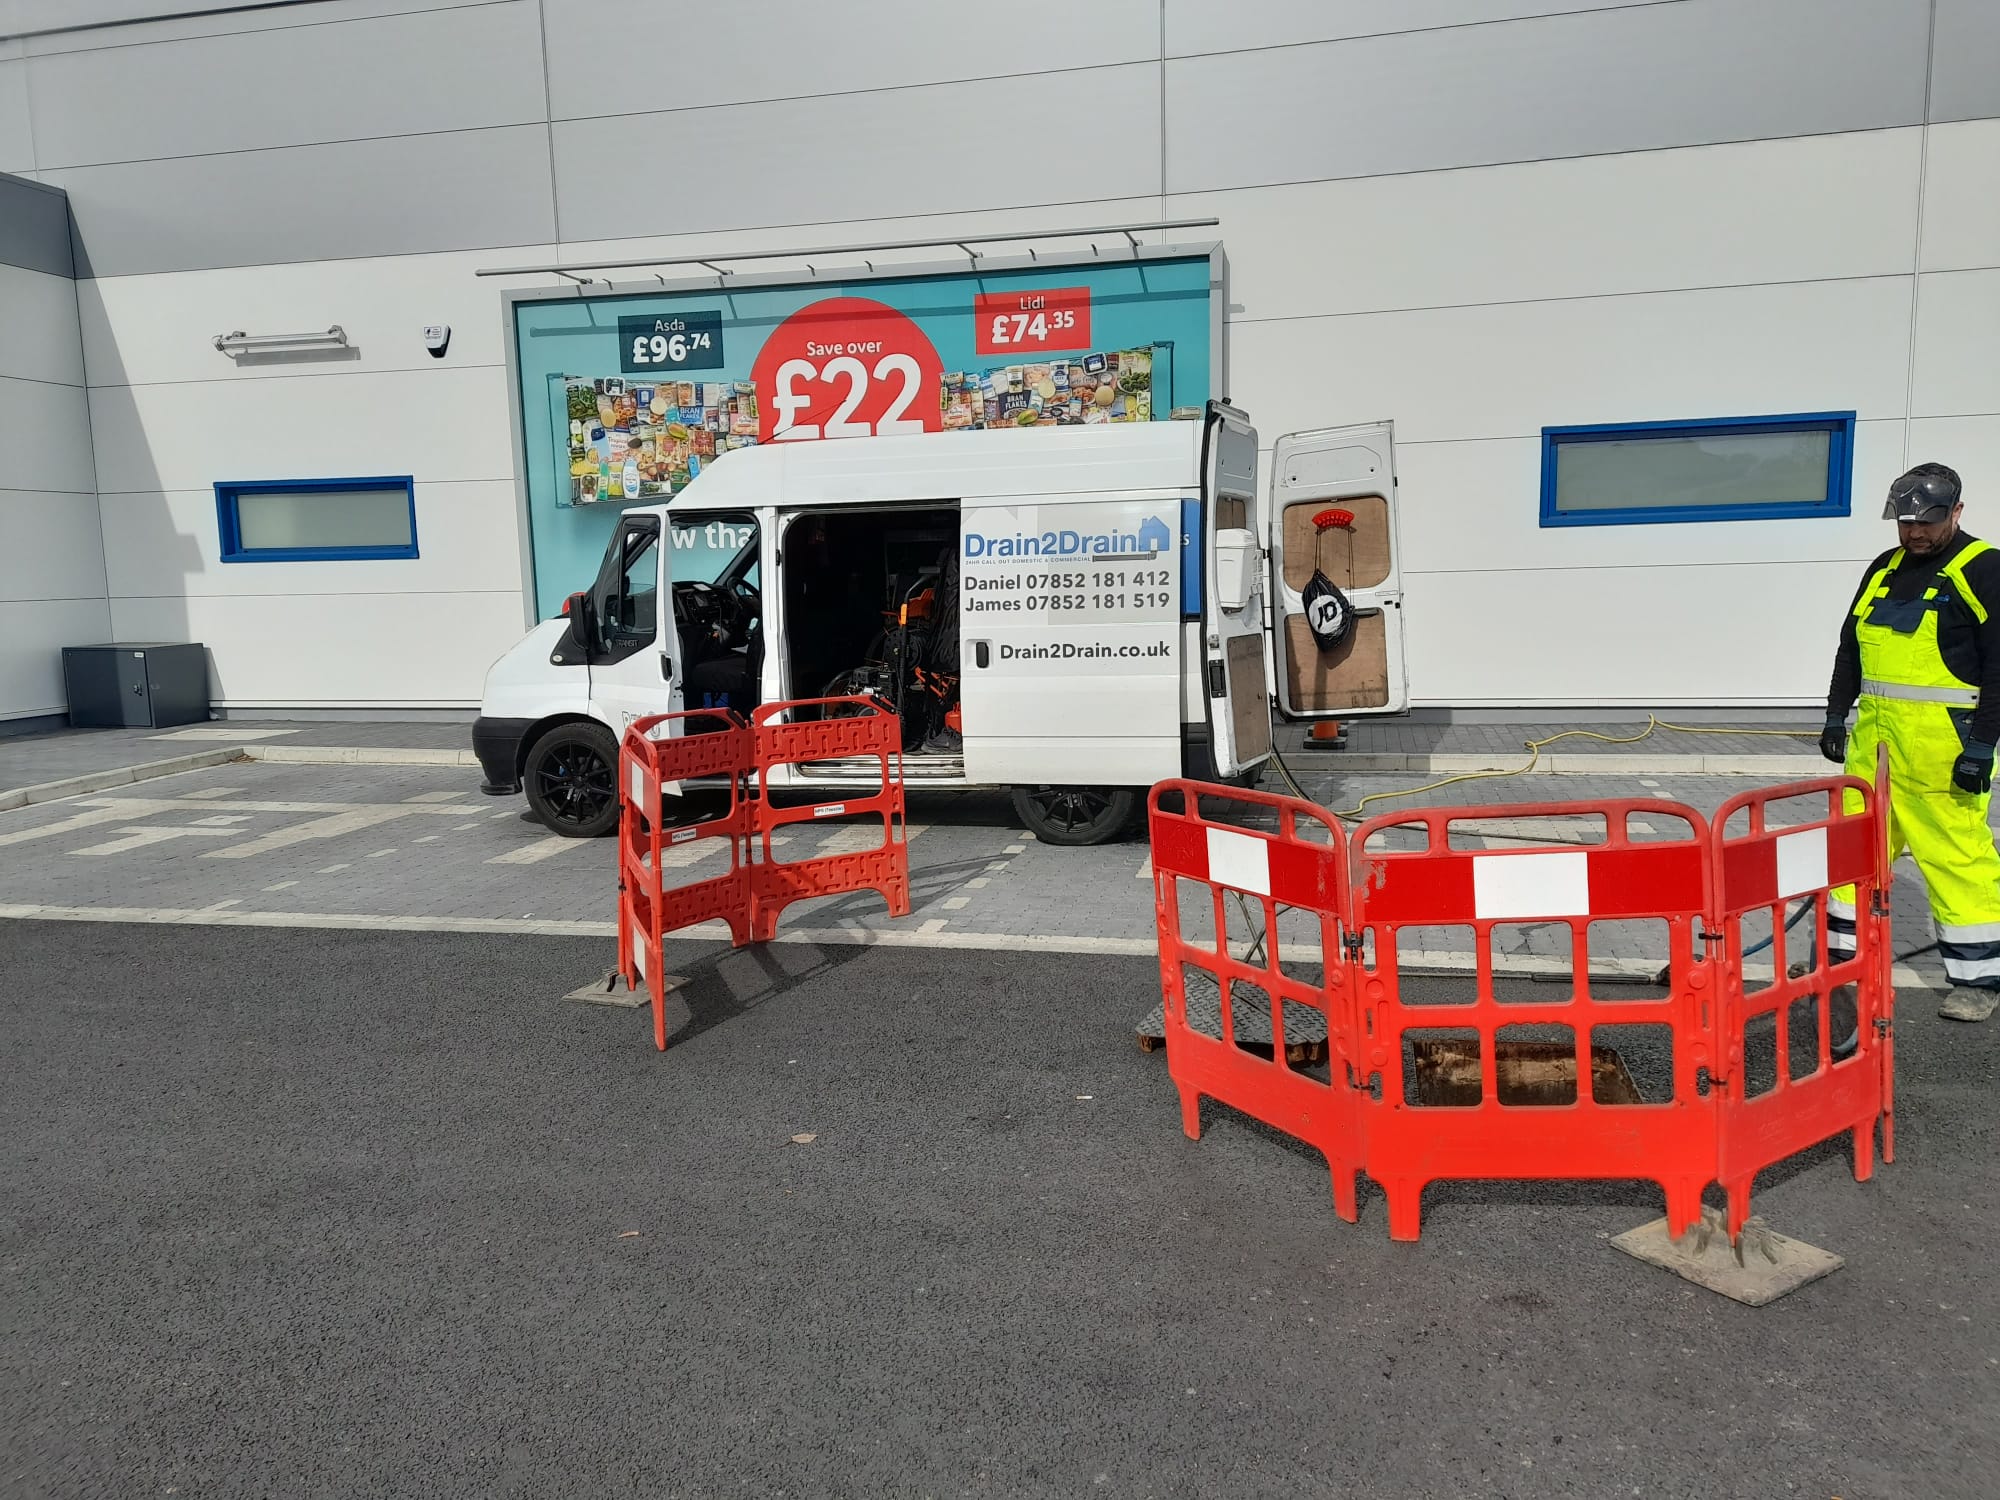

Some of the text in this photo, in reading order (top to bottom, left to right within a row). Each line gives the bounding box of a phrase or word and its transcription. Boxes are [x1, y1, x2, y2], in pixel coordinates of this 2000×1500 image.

[1020, 296, 1045, 310] Lidl
[654, 319, 686, 332] Asda
[991, 310, 1075, 344] £74.35
[633, 333, 711, 363] £96.74
[806, 341, 883, 356] Save over
[772, 353, 924, 440] £22
[1005, 401, 1027, 410] FLAKES
[965, 529, 1137, 557] Drain2Drain
[965, 571, 1170, 590] Daniel 07852 181 412
[965, 592, 1170, 611] James 07852 181 519
[1317, 601, 1338, 630] JD
[1000, 641, 1170, 659] Drain2Drain.co.uk
